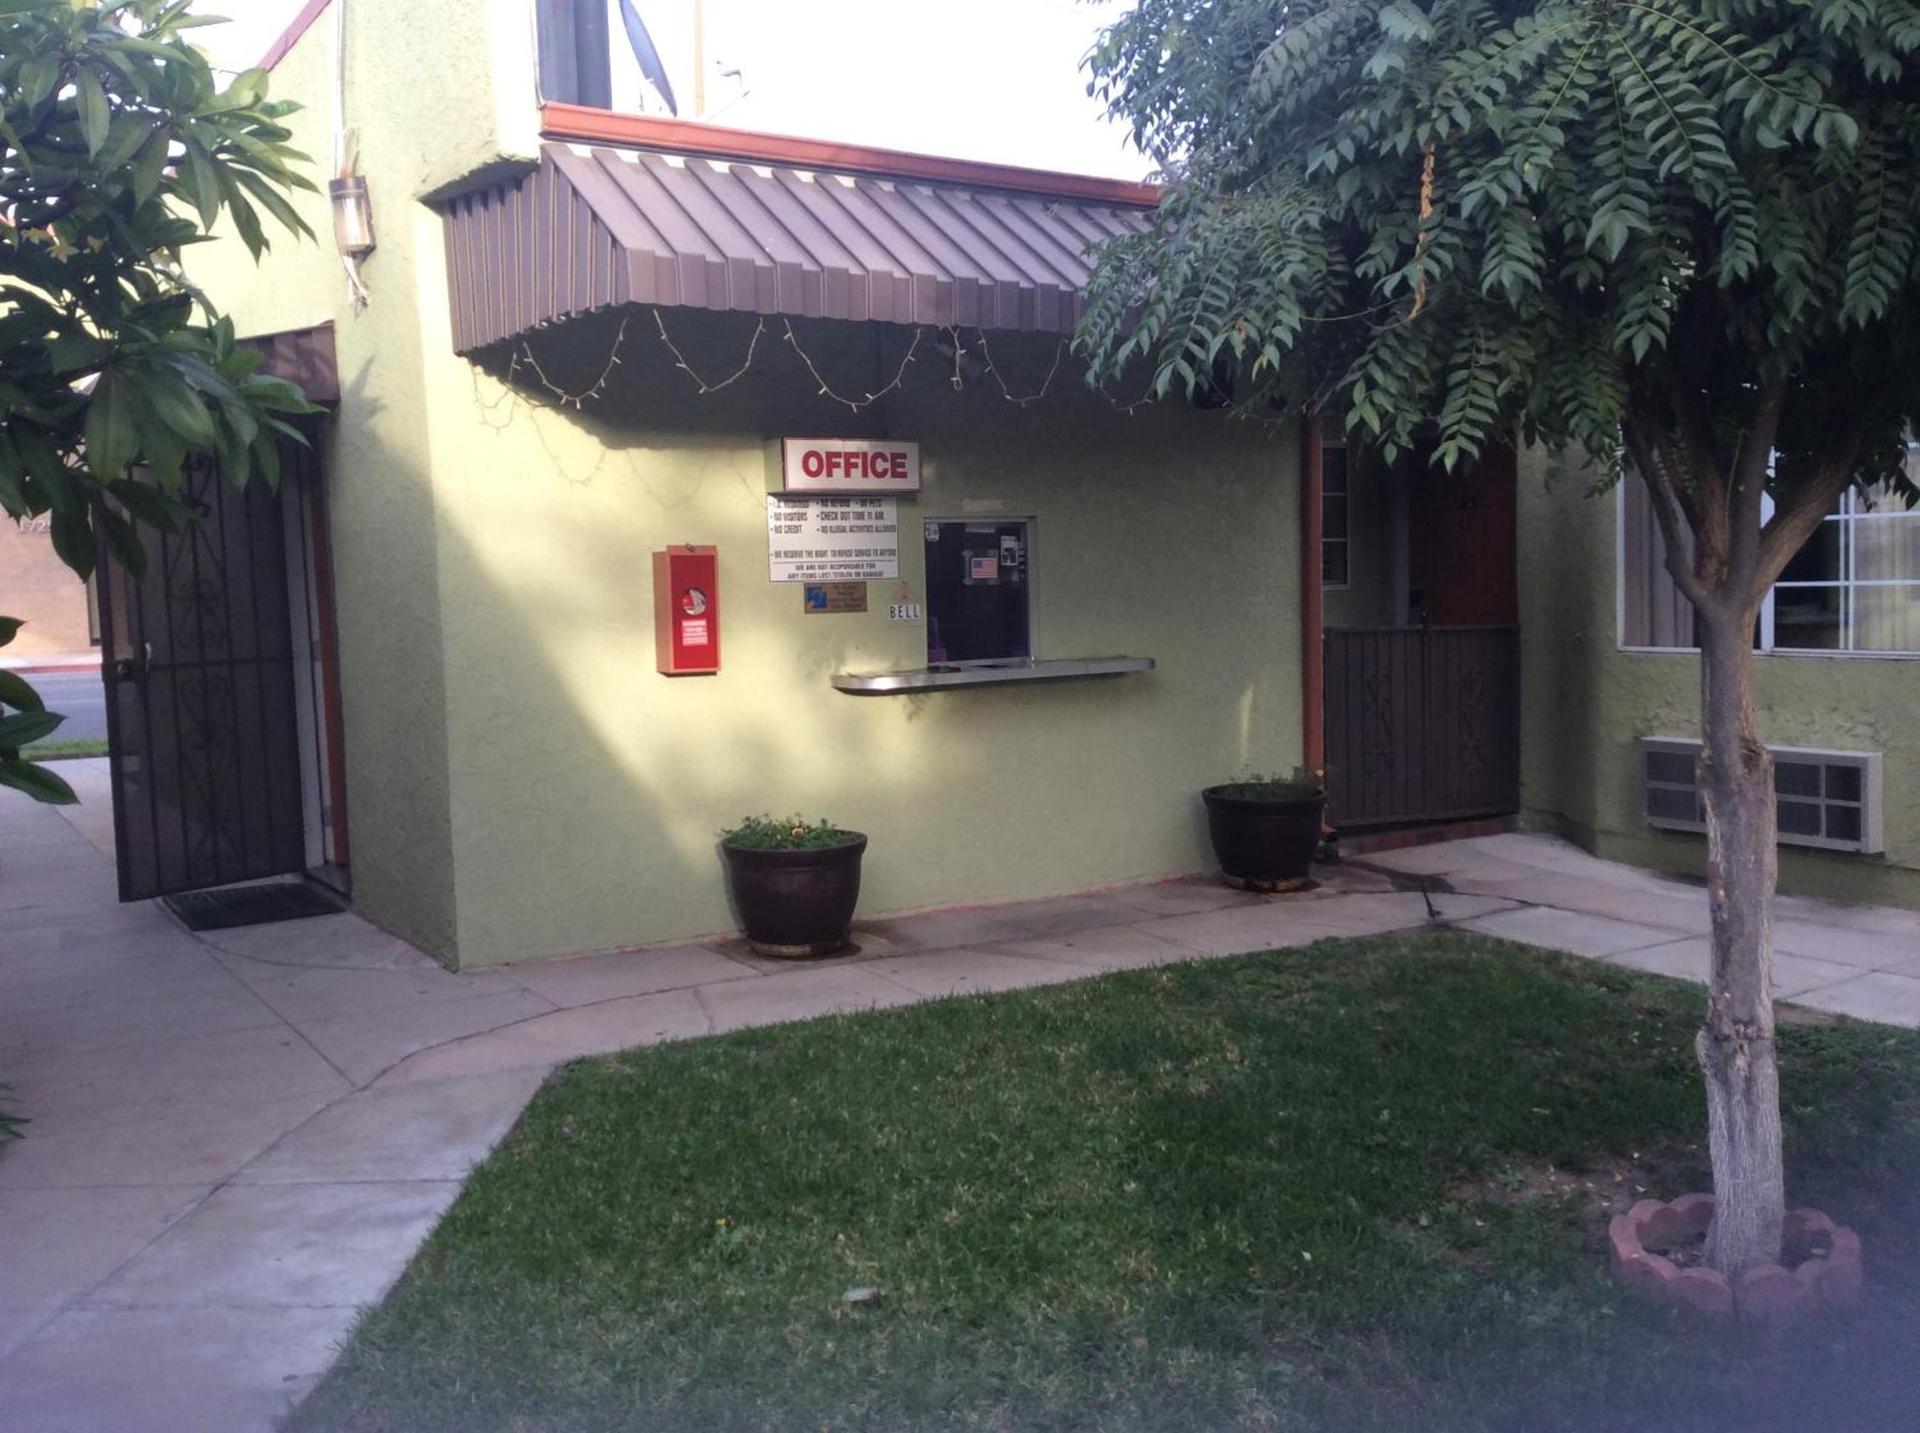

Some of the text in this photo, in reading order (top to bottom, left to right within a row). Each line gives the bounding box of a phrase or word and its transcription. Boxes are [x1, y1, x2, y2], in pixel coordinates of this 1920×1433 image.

[802, 450, 908, 479] OFFICE
[774, 512, 808, 521] NO VISITORS
[820, 511, 838, 521] CHECK
[840, 511, 850, 521] OUT
[852, 511, 865, 521] TIME
[774, 525, 802, 534] NO CREDIT
[821, 525, 896, 533] NO ILLEGAL ACTIVITIES ALLOWED
[774, 550, 782, 558] WE
[783, 550, 803, 558] RESERVE
[804, 550, 813, 558] THE
[815, 550, 828, 558] RIGHT
[831, 549, 837, 557] TO
[838, 549, 853, 557] REFUSE
[854, 549, 872, 557] SERVICE
[890, 602, 919, 618] BELL
